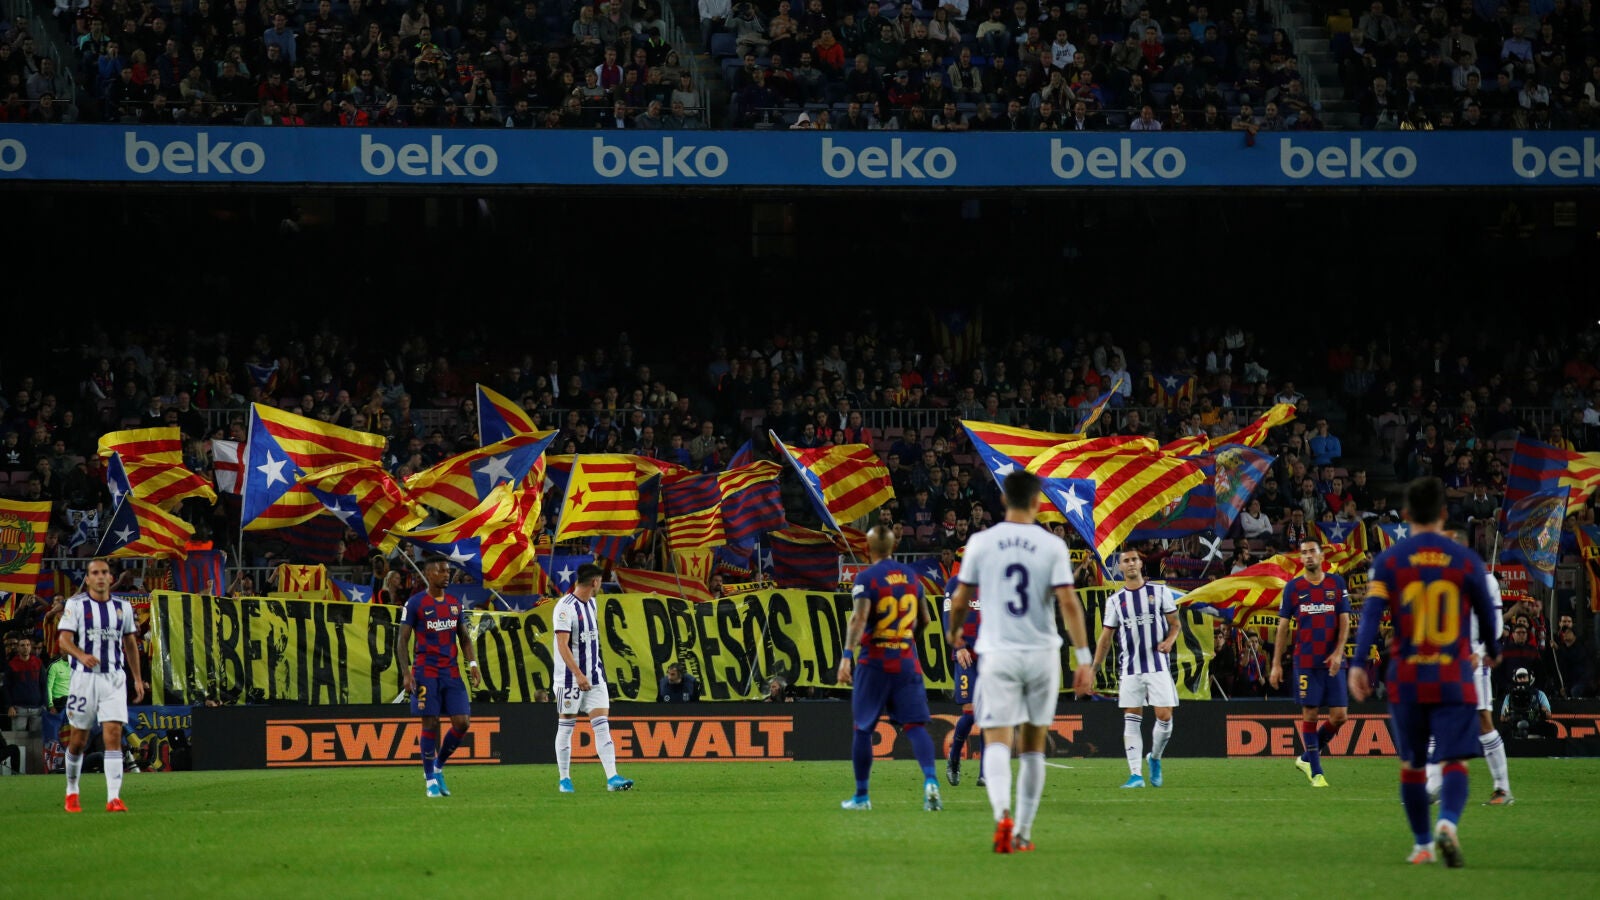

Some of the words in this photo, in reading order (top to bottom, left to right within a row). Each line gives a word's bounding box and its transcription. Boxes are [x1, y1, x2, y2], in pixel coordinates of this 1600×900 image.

[126, 133, 265, 174] beko
[362, 135, 498, 177] beko
[594, 137, 729, 178] beko
[823, 138, 957, 179] beko
[1052, 139, 1186, 179] beko
[1281, 139, 1416, 179] beko
[1004, 562, 1030, 618] 3
[874, 593, 918, 639] 22
[1400, 579, 1460, 647] 10
[158, 594, 354, 704] LLIBERTAT
[418, 685, 428, 701] 2
[564, 687, 580, 700] 23
[960, 674, 969, 690] 3
[1298, 675, 1308, 690] 5
[67, 694, 87, 713] 22
